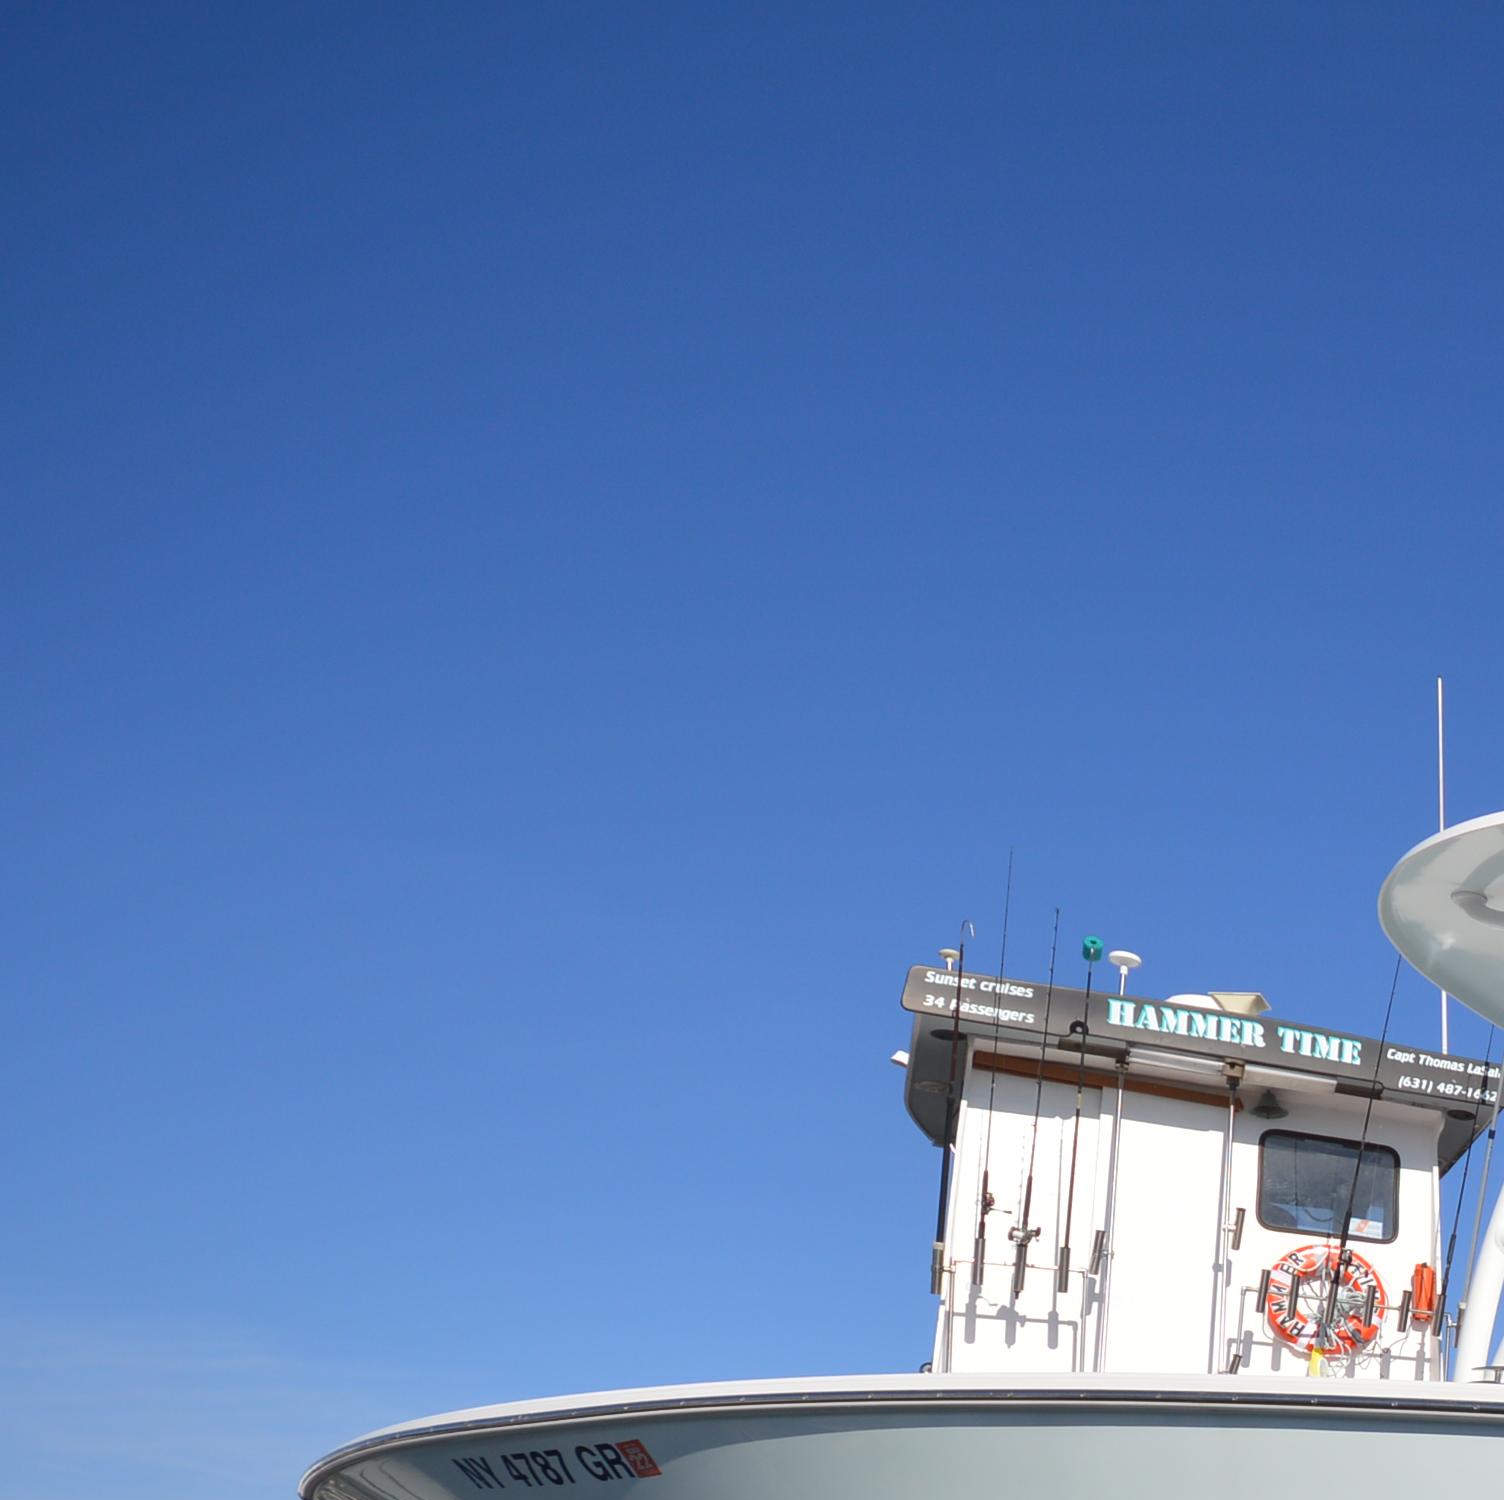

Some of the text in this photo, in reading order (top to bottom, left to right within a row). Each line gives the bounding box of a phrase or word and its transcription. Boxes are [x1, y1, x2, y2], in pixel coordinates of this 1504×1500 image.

[924, 971, 1034, 998] Sunset cruises
[923, 994, 945, 1008] 34
[1107, 998, 1362, 1065] HAMMER TIME
[1386, 1048, 1416, 1064] Capt
[1419, 1054, 1465, 1073] Thomas
[1398, 1075, 1499, 1102] (631) 487-1662
[451, 1443, 637, 1489] NY 4787 GR
